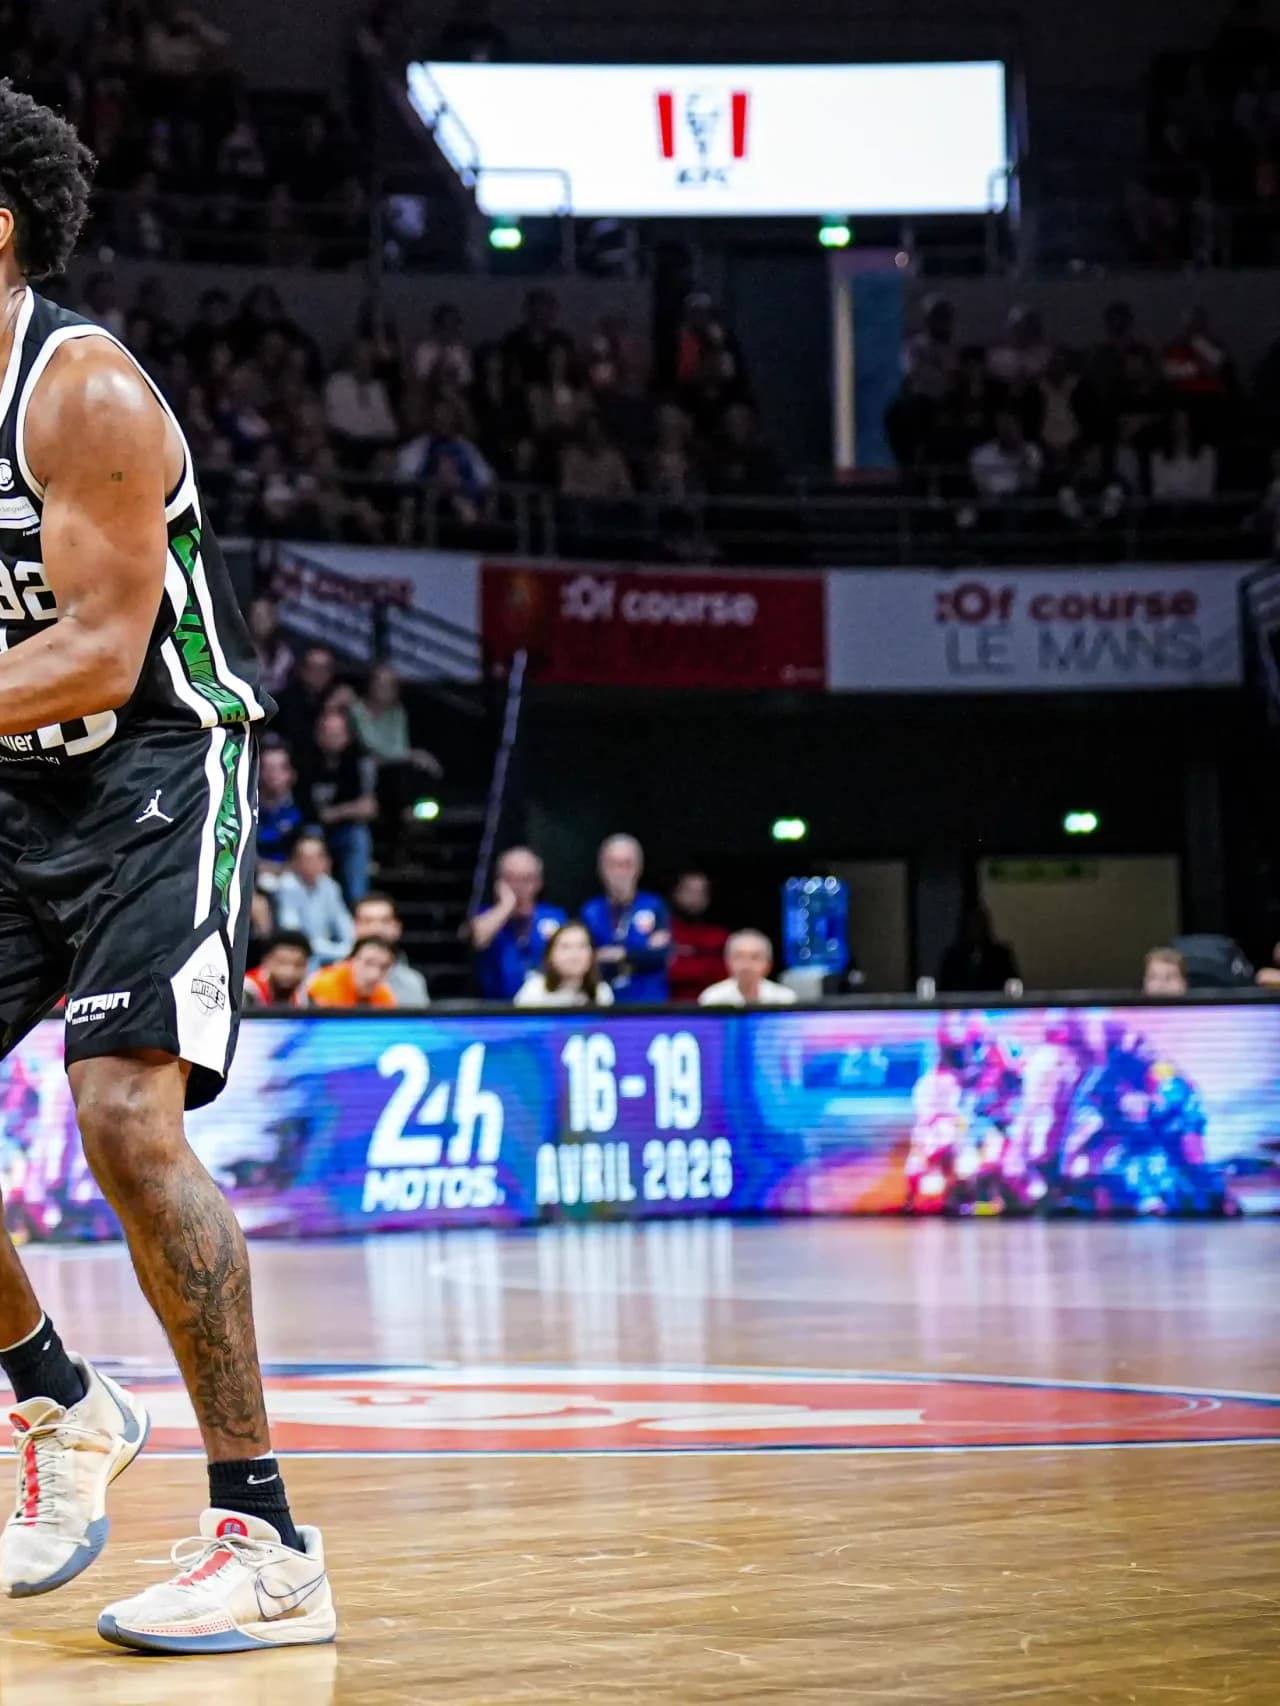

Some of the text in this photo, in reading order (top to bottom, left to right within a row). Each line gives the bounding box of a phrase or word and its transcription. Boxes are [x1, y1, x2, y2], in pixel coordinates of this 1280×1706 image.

[621, 587, 758, 627] course
[1027, 589, 1199, 624] course
[946, 620, 1204, 675] LE MANS
[366, 1031, 702, 1168] 24h 16-19
[535, 1136, 734, 1205] AVRIL 2026
